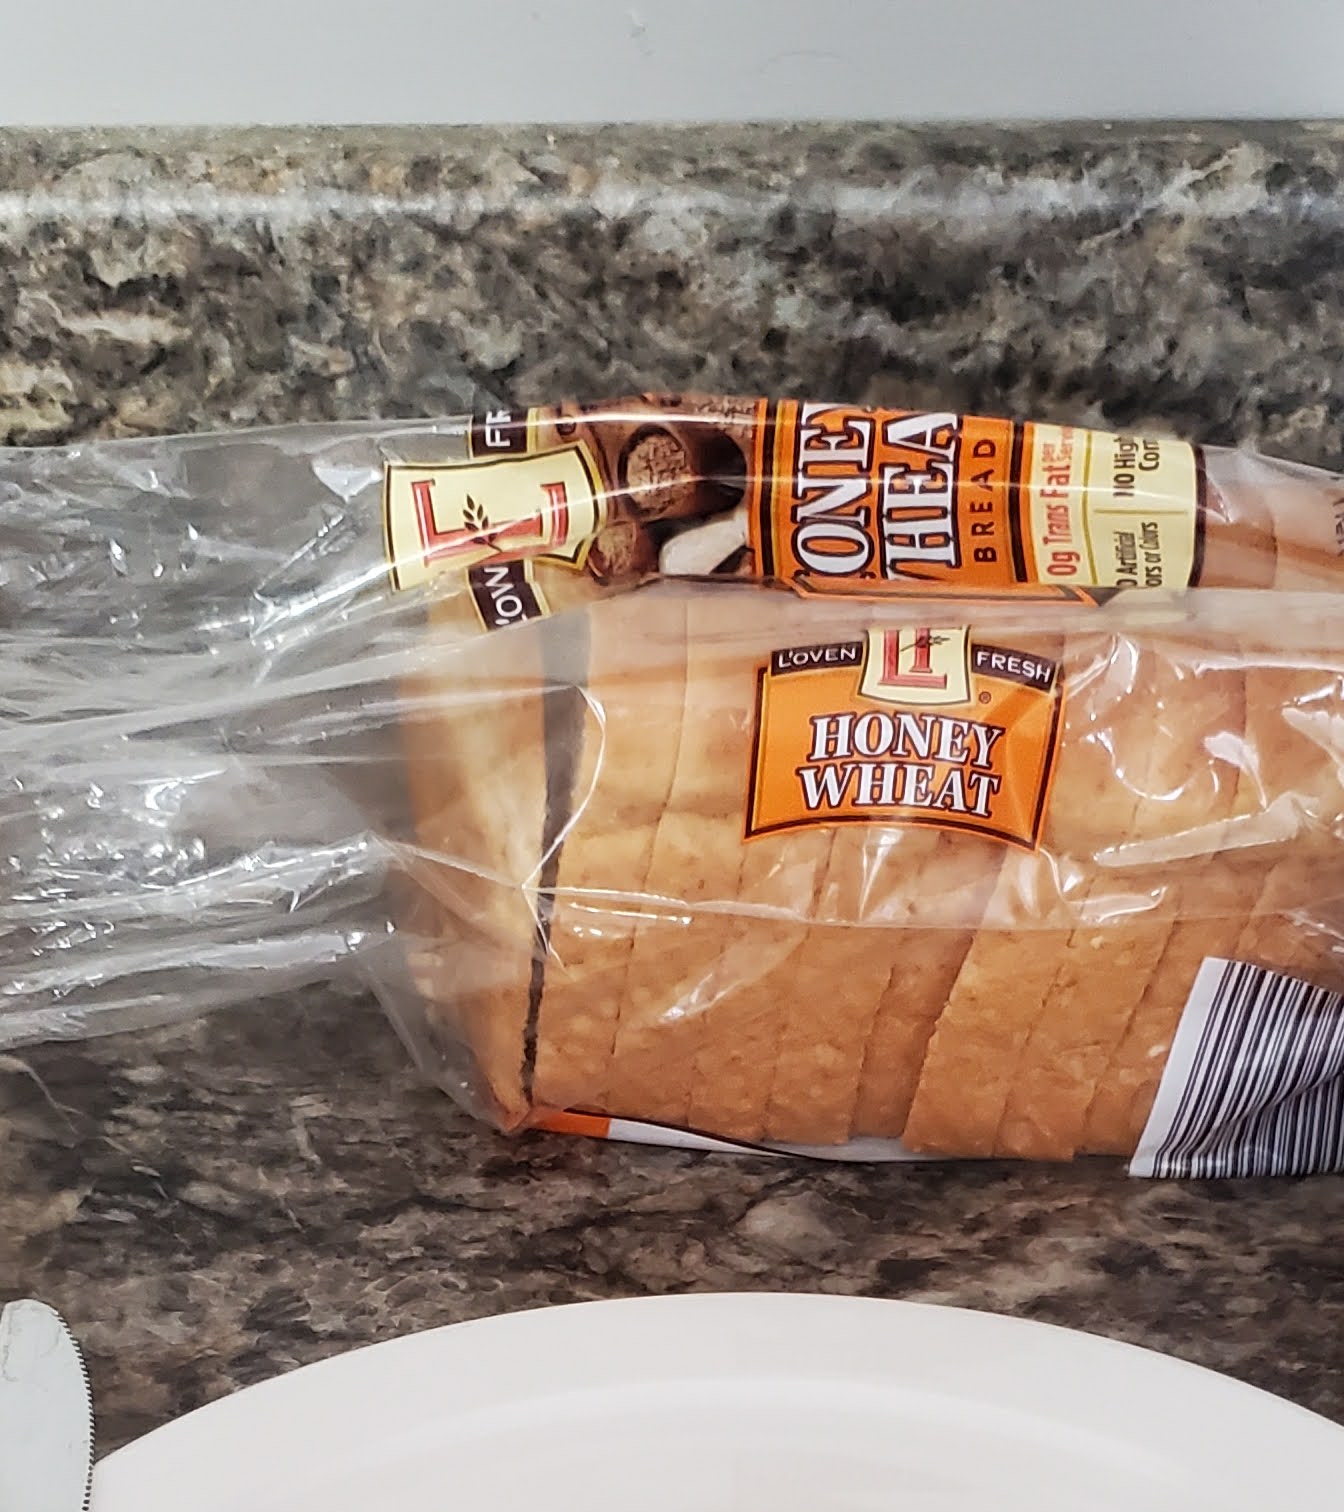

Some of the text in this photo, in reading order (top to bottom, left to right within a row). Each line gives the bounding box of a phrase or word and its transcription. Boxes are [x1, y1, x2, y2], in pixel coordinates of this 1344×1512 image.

[883, 412, 958, 580] HEA
[970, 438, 997, 563] BREAD
[1039, 464, 1073, 499] Fat
[1042, 503, 1073, 545] Trans
[777, 646, 857, 669] L'OVEN
[975, 651, 1052, 684] FRESH
[809, 711, 1003, 768] HONEY
[798, 763, 1001, 817] WHEAT
